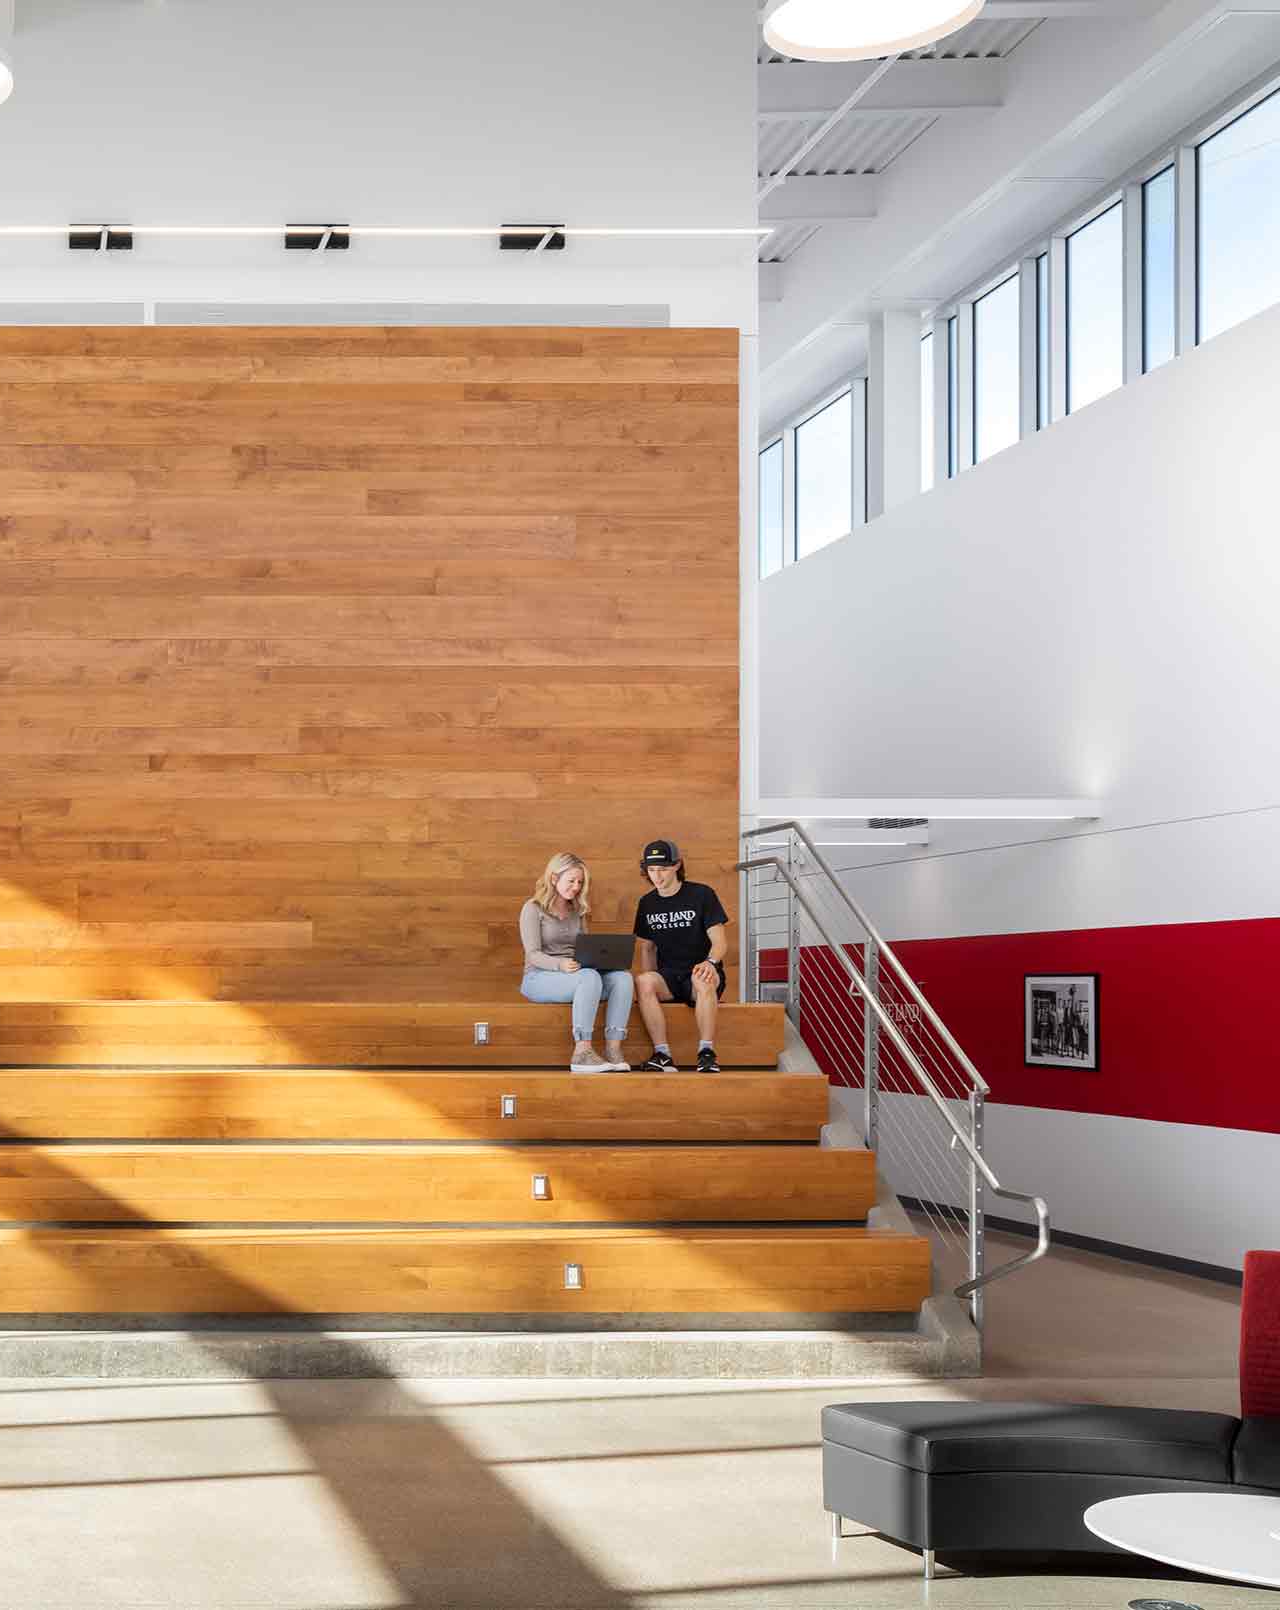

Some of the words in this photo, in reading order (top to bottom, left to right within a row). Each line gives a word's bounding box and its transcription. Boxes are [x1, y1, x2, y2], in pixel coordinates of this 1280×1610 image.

[646, 913, 669, 925] LAKE
[669, 910, 696, 923] LAND
[651, 921, 692, 930] COLLEGE
